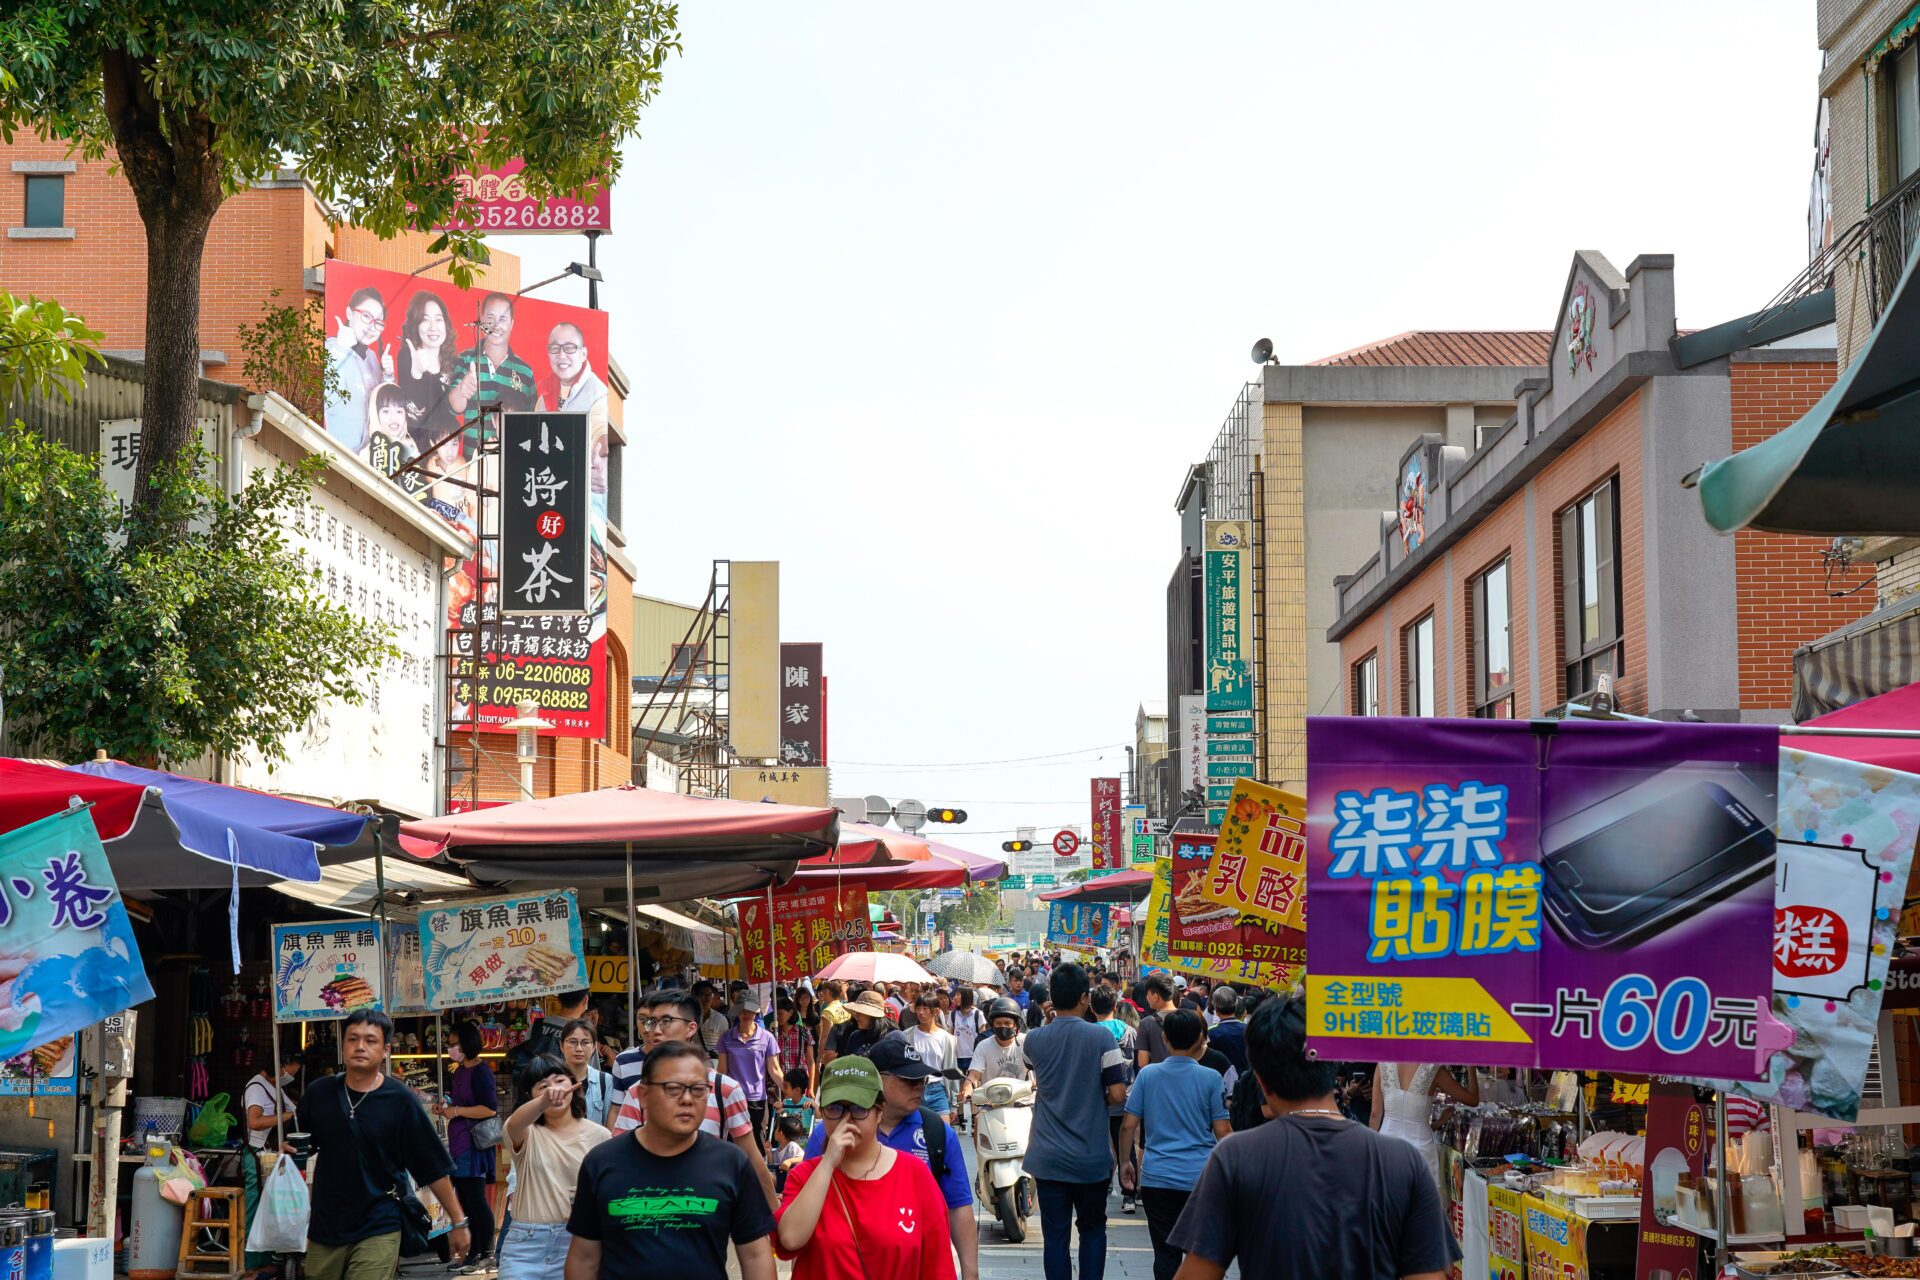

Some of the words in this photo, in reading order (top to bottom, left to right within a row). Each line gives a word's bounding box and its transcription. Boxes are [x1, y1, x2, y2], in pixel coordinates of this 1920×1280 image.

[455, 178, 551, 201] 團體合
[515, 421, 573, 603] 小將好茶
[1221, 554, 1237, 681] 安平旅遊資訊中心
[495, 661, 591, 686] 06-2206088
[493, 685, 588, 709] 0955268882
[785, 666, 810, 767] 陳家蚵
[758, 771, 800, 783] 府城美食
[1333, 786, 1503, 873] 柒柒
[459, 896, 569, 933] 旗魚黑輪
[1371, 867, 1543, 960] 貼膜
[283, 929, 374, 951] 旗魚黑輪
[468, 952, 506, 987] 現做
[750, 944, 835, 979] 原味香腸
[1323, 981, 1404, 1008] 全型號
[1323, 1009, 1492, 1038] 9H鋼化玻璃貼
[830, 1068, 869, 1078] Together
[1688, 1111, 1700, 1151] 珍珠Q
